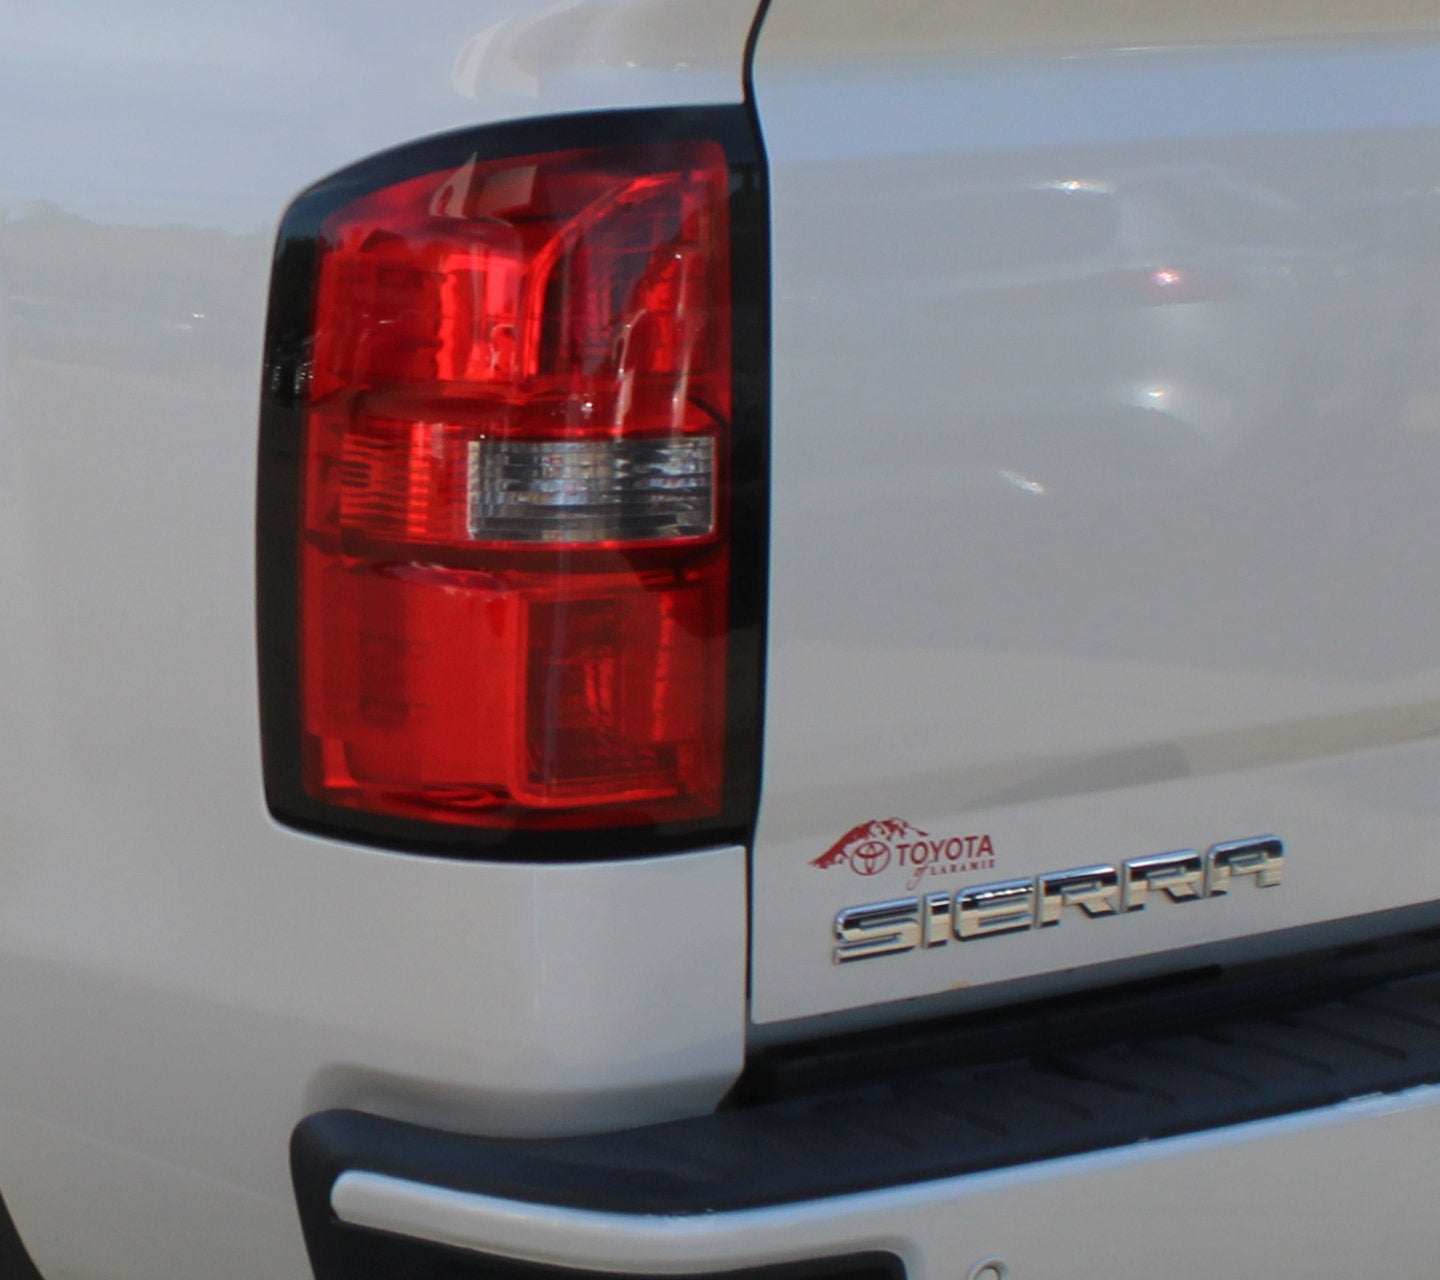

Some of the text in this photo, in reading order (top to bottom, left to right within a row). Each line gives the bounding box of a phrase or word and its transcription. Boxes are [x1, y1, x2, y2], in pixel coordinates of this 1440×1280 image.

[895, 834, 995, 867] TOYOTA
[929, 858, 996, 876] LARAMIE
[833, 833, 1284, 965] SIERRA
